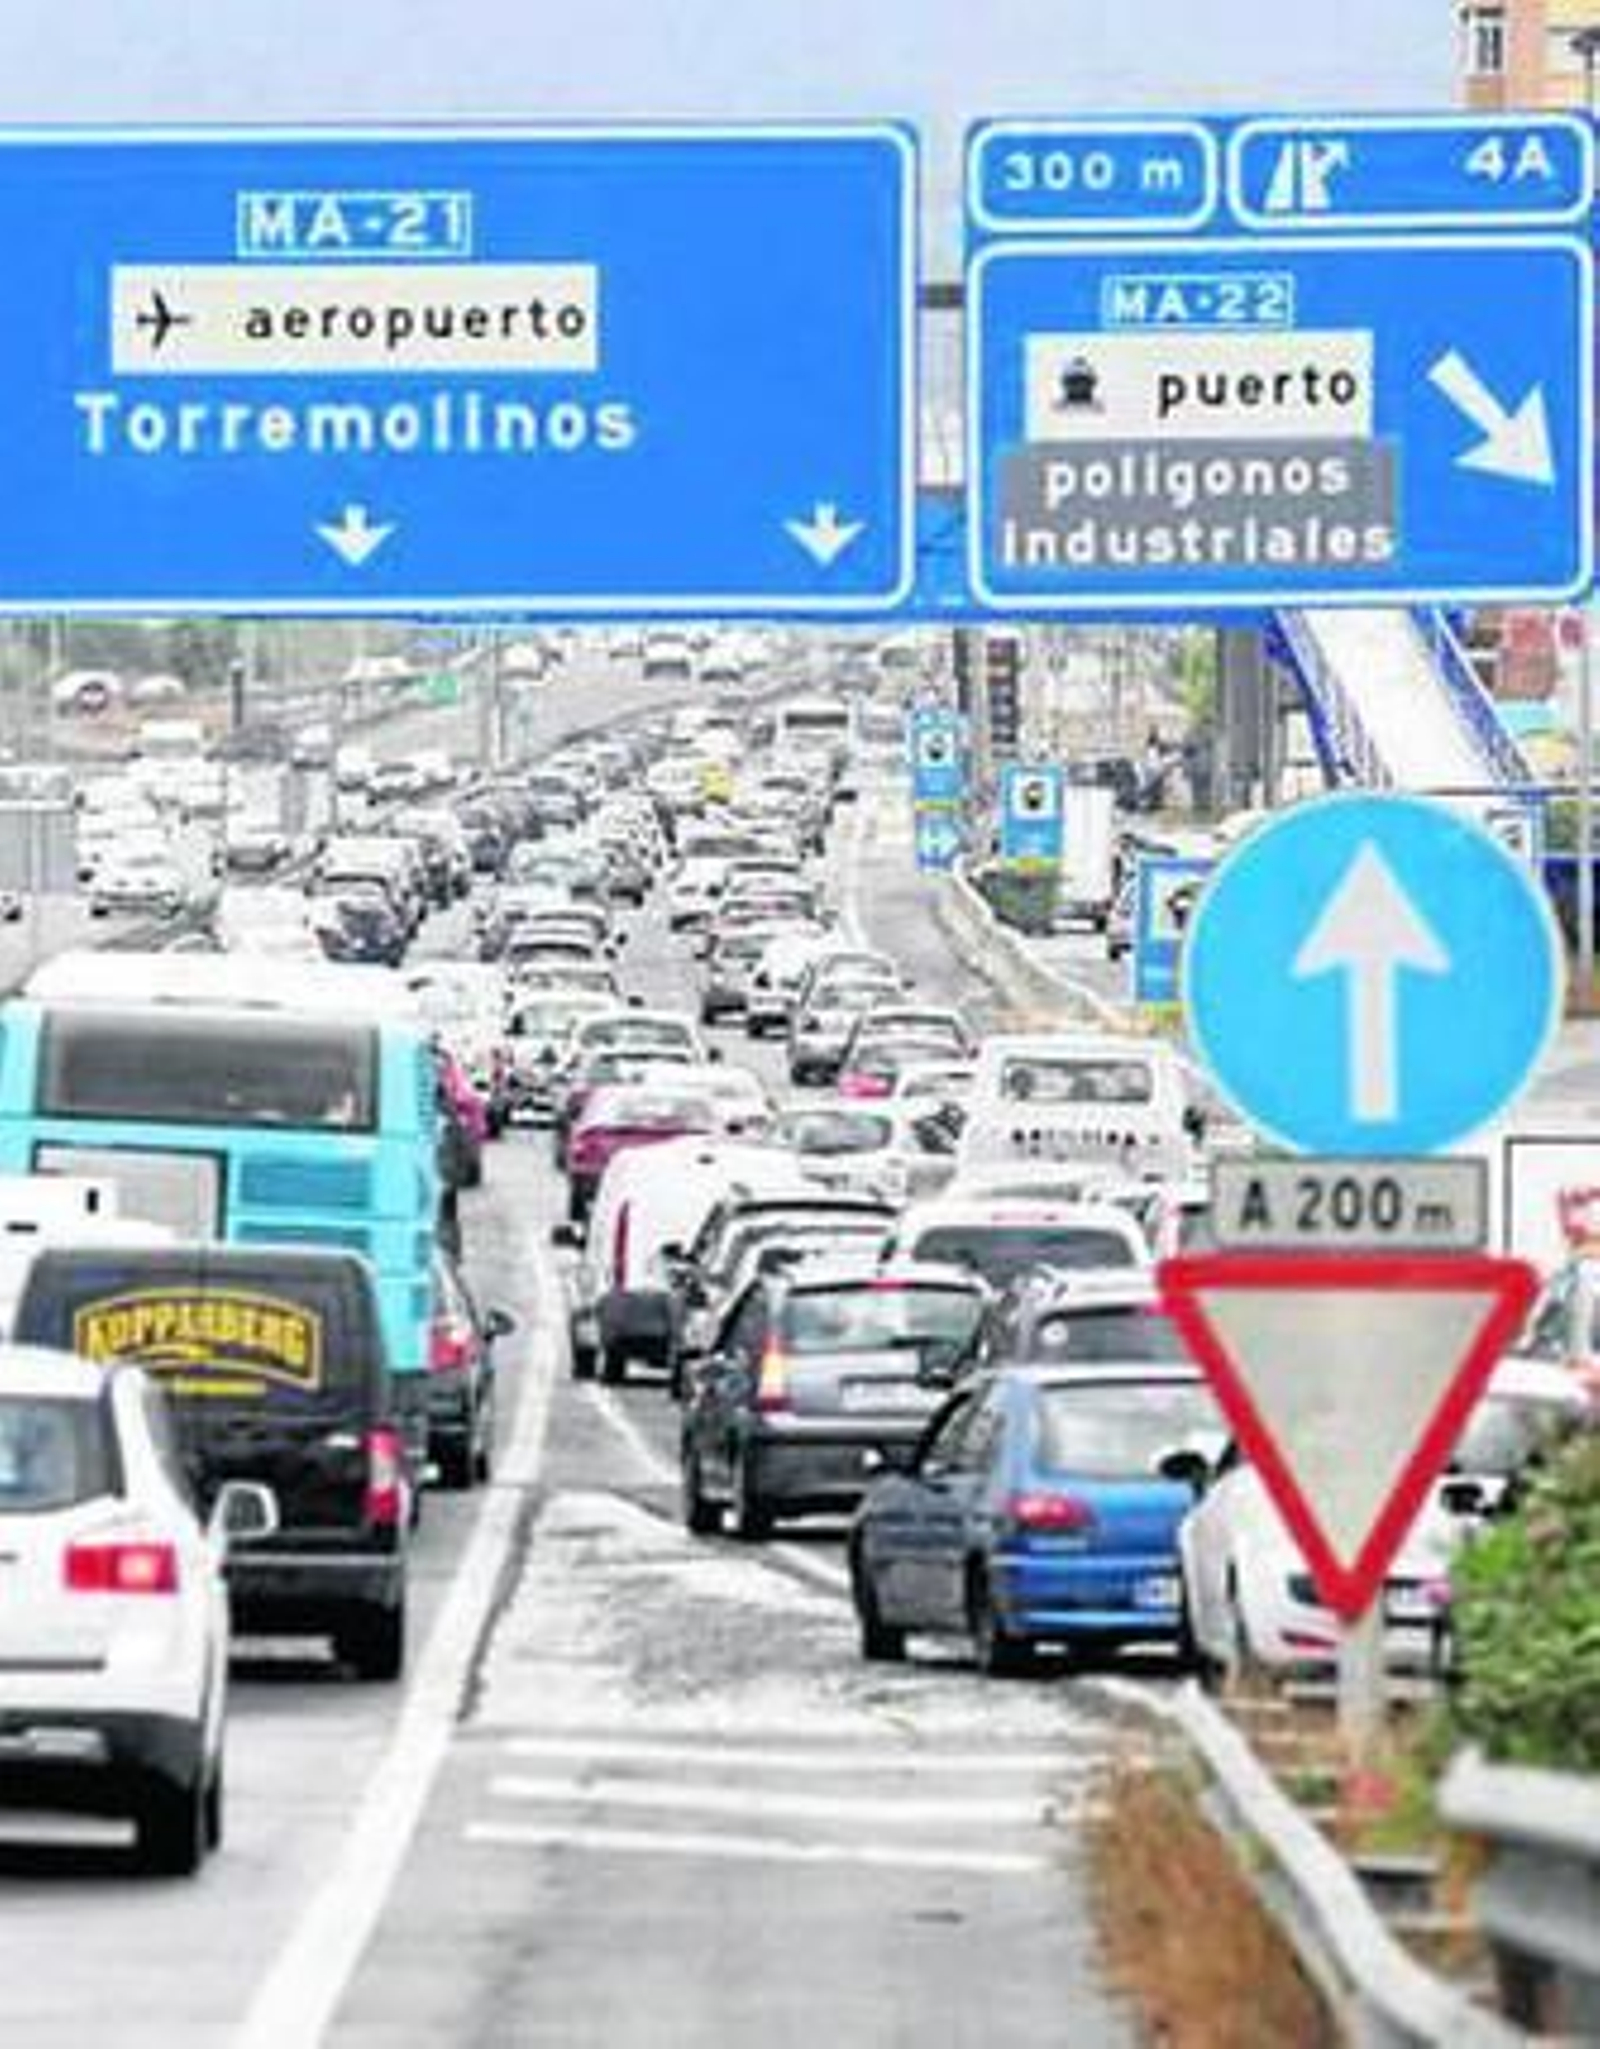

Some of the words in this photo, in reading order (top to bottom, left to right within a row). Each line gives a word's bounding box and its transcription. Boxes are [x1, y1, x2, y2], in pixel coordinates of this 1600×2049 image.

[1004, 152, 1112, 191] 300
[1142, 157, 1184, 189] m
[1467, 136, 1554, 181] 4A
[247, 201, 464, 249] MA-21
[244, 299, 587, 348] aeropuerto
[1112, 282, 1286, 321] MA-22
[1157, 367, 1357, 418] puerto
[75, 391, 637, 452] Torremolinos
[1003, 516, 1394, 566] industriales
[1238, 1180, 1273, 1229] A
[1296, 1177, 1402, 1230] 200
[1415, 1203, 1453, 1228] m
